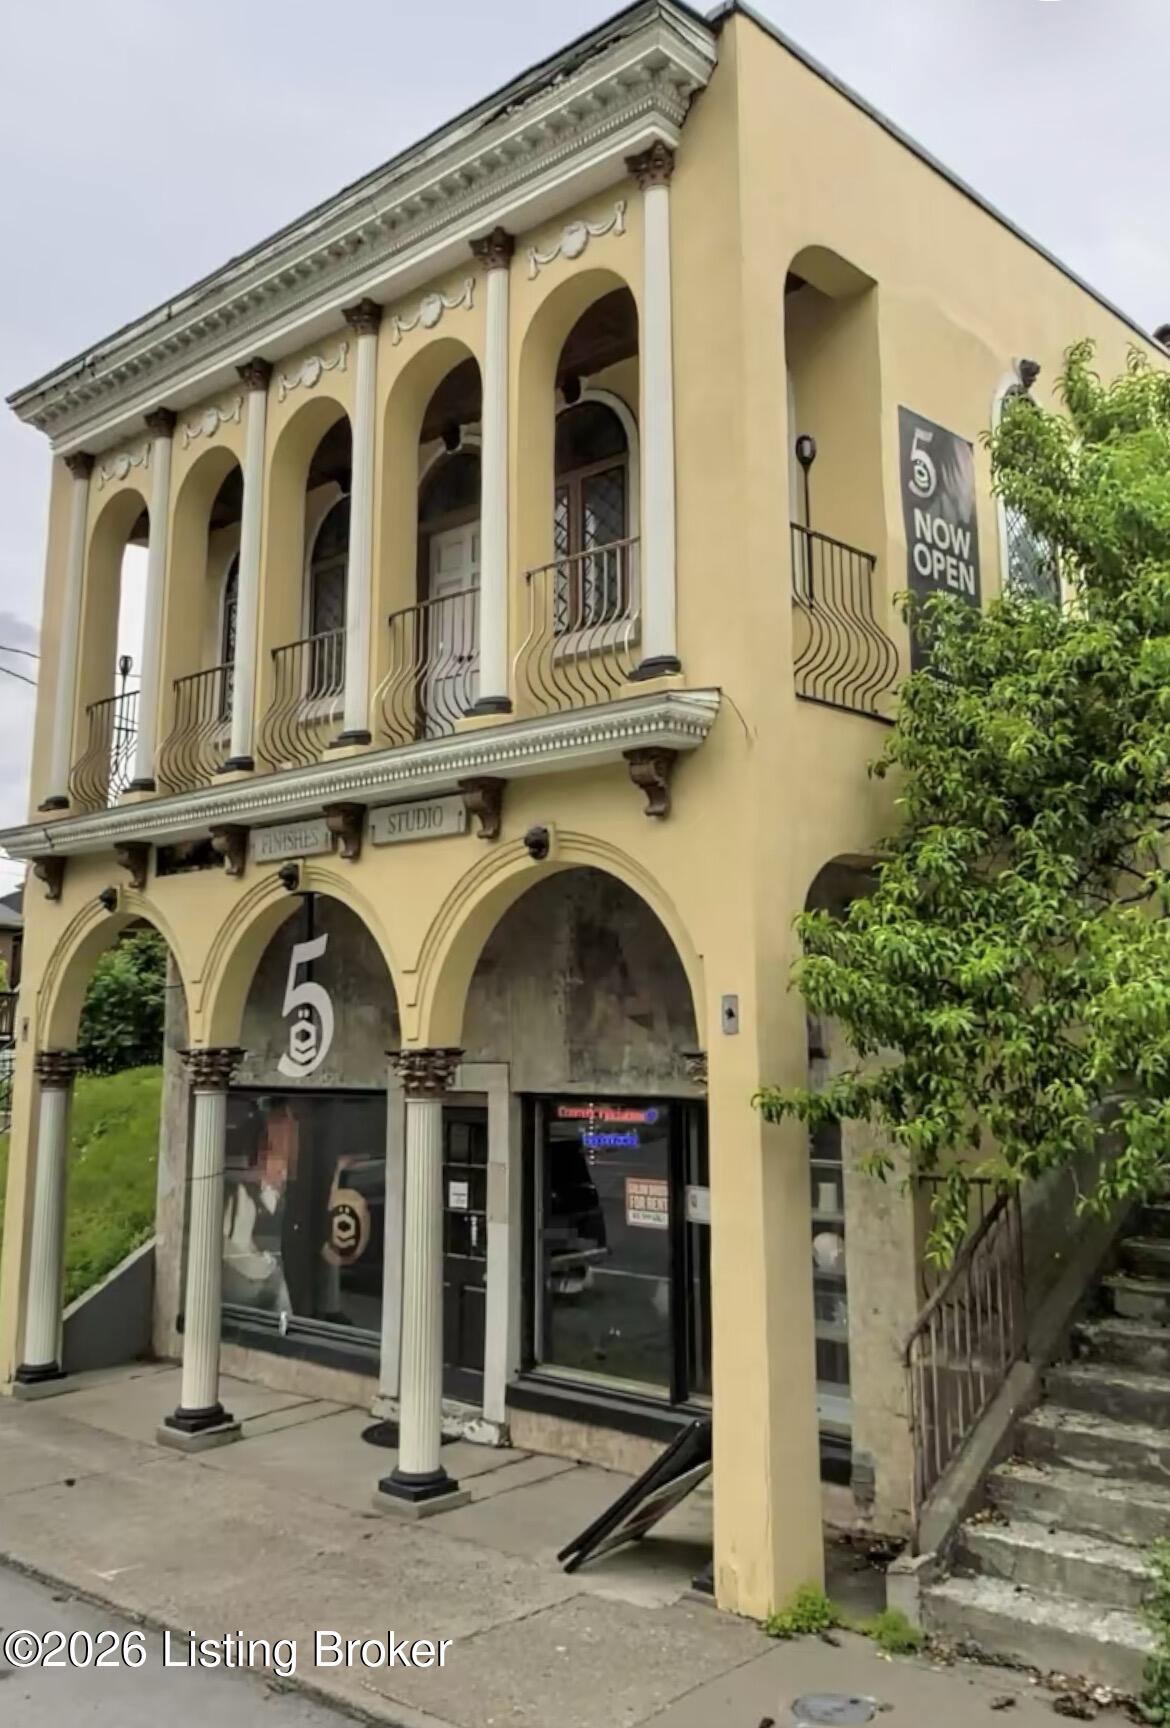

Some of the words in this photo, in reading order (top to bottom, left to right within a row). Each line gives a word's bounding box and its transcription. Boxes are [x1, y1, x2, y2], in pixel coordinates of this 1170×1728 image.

[914, 508, 971, 560] NOW
[913, 543, 975, 595] OPEN
[262, 830, 319, 853] FINISHES
[388, 805, 443, 834] STUDIO
[277, 933, 334, 1079] 5
